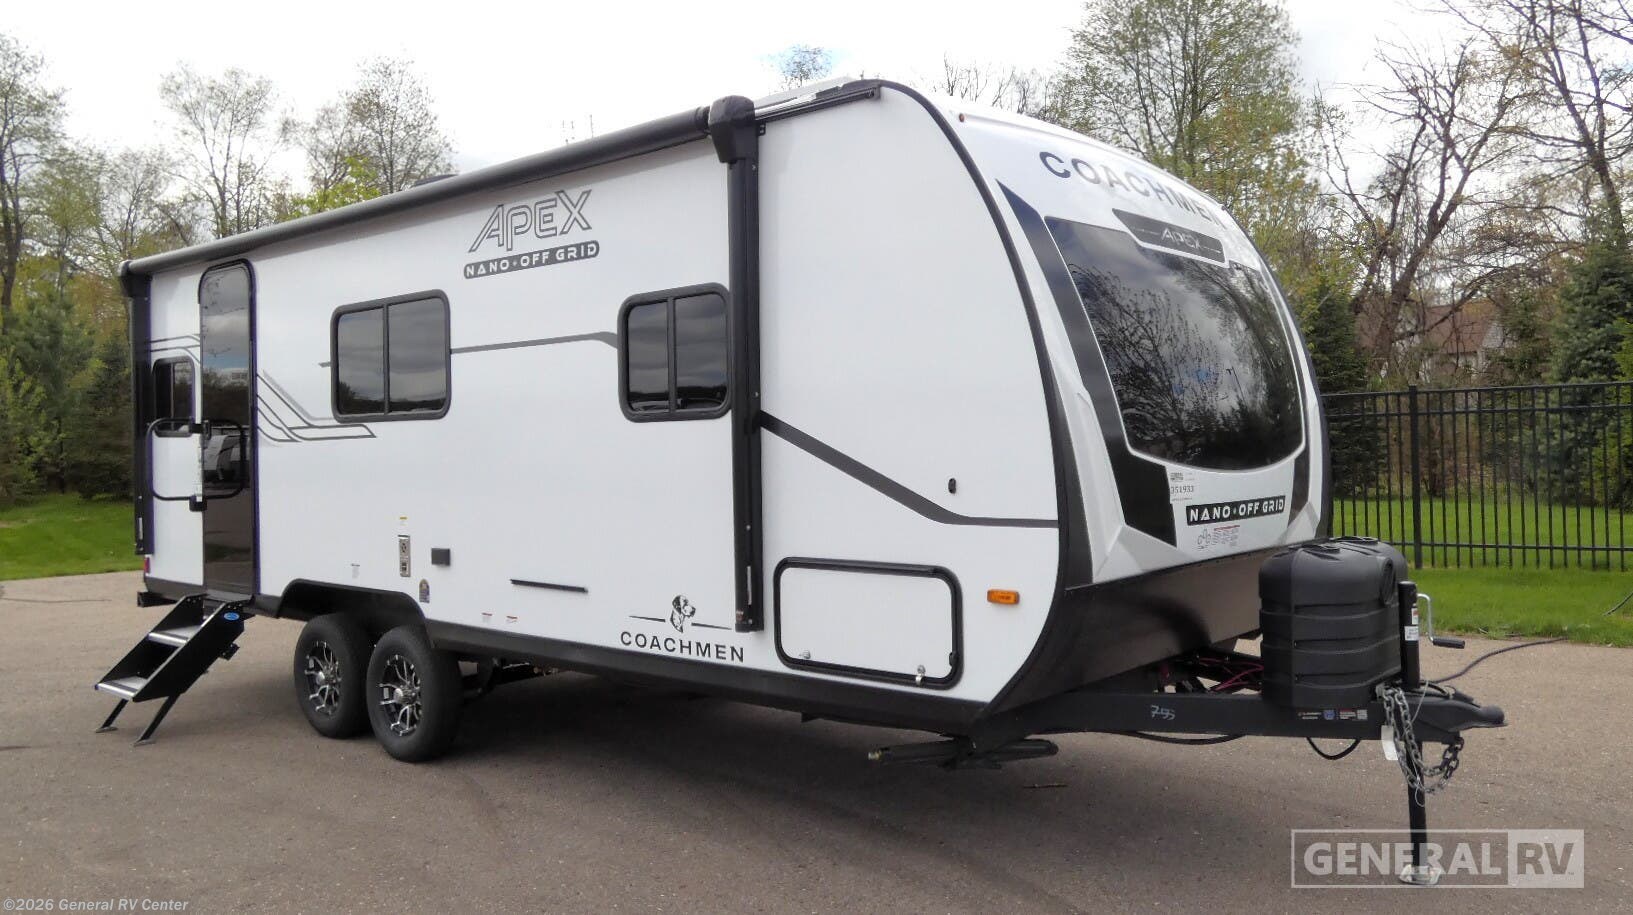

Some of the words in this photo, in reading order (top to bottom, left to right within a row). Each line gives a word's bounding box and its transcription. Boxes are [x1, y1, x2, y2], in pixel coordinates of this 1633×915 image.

[468, 189, 592, 252] APEX
[555, 243, 597, 261] GRID
[1262, 498, 1284, 513] GRID
[620, 631, 744, 662] COACHMEN
